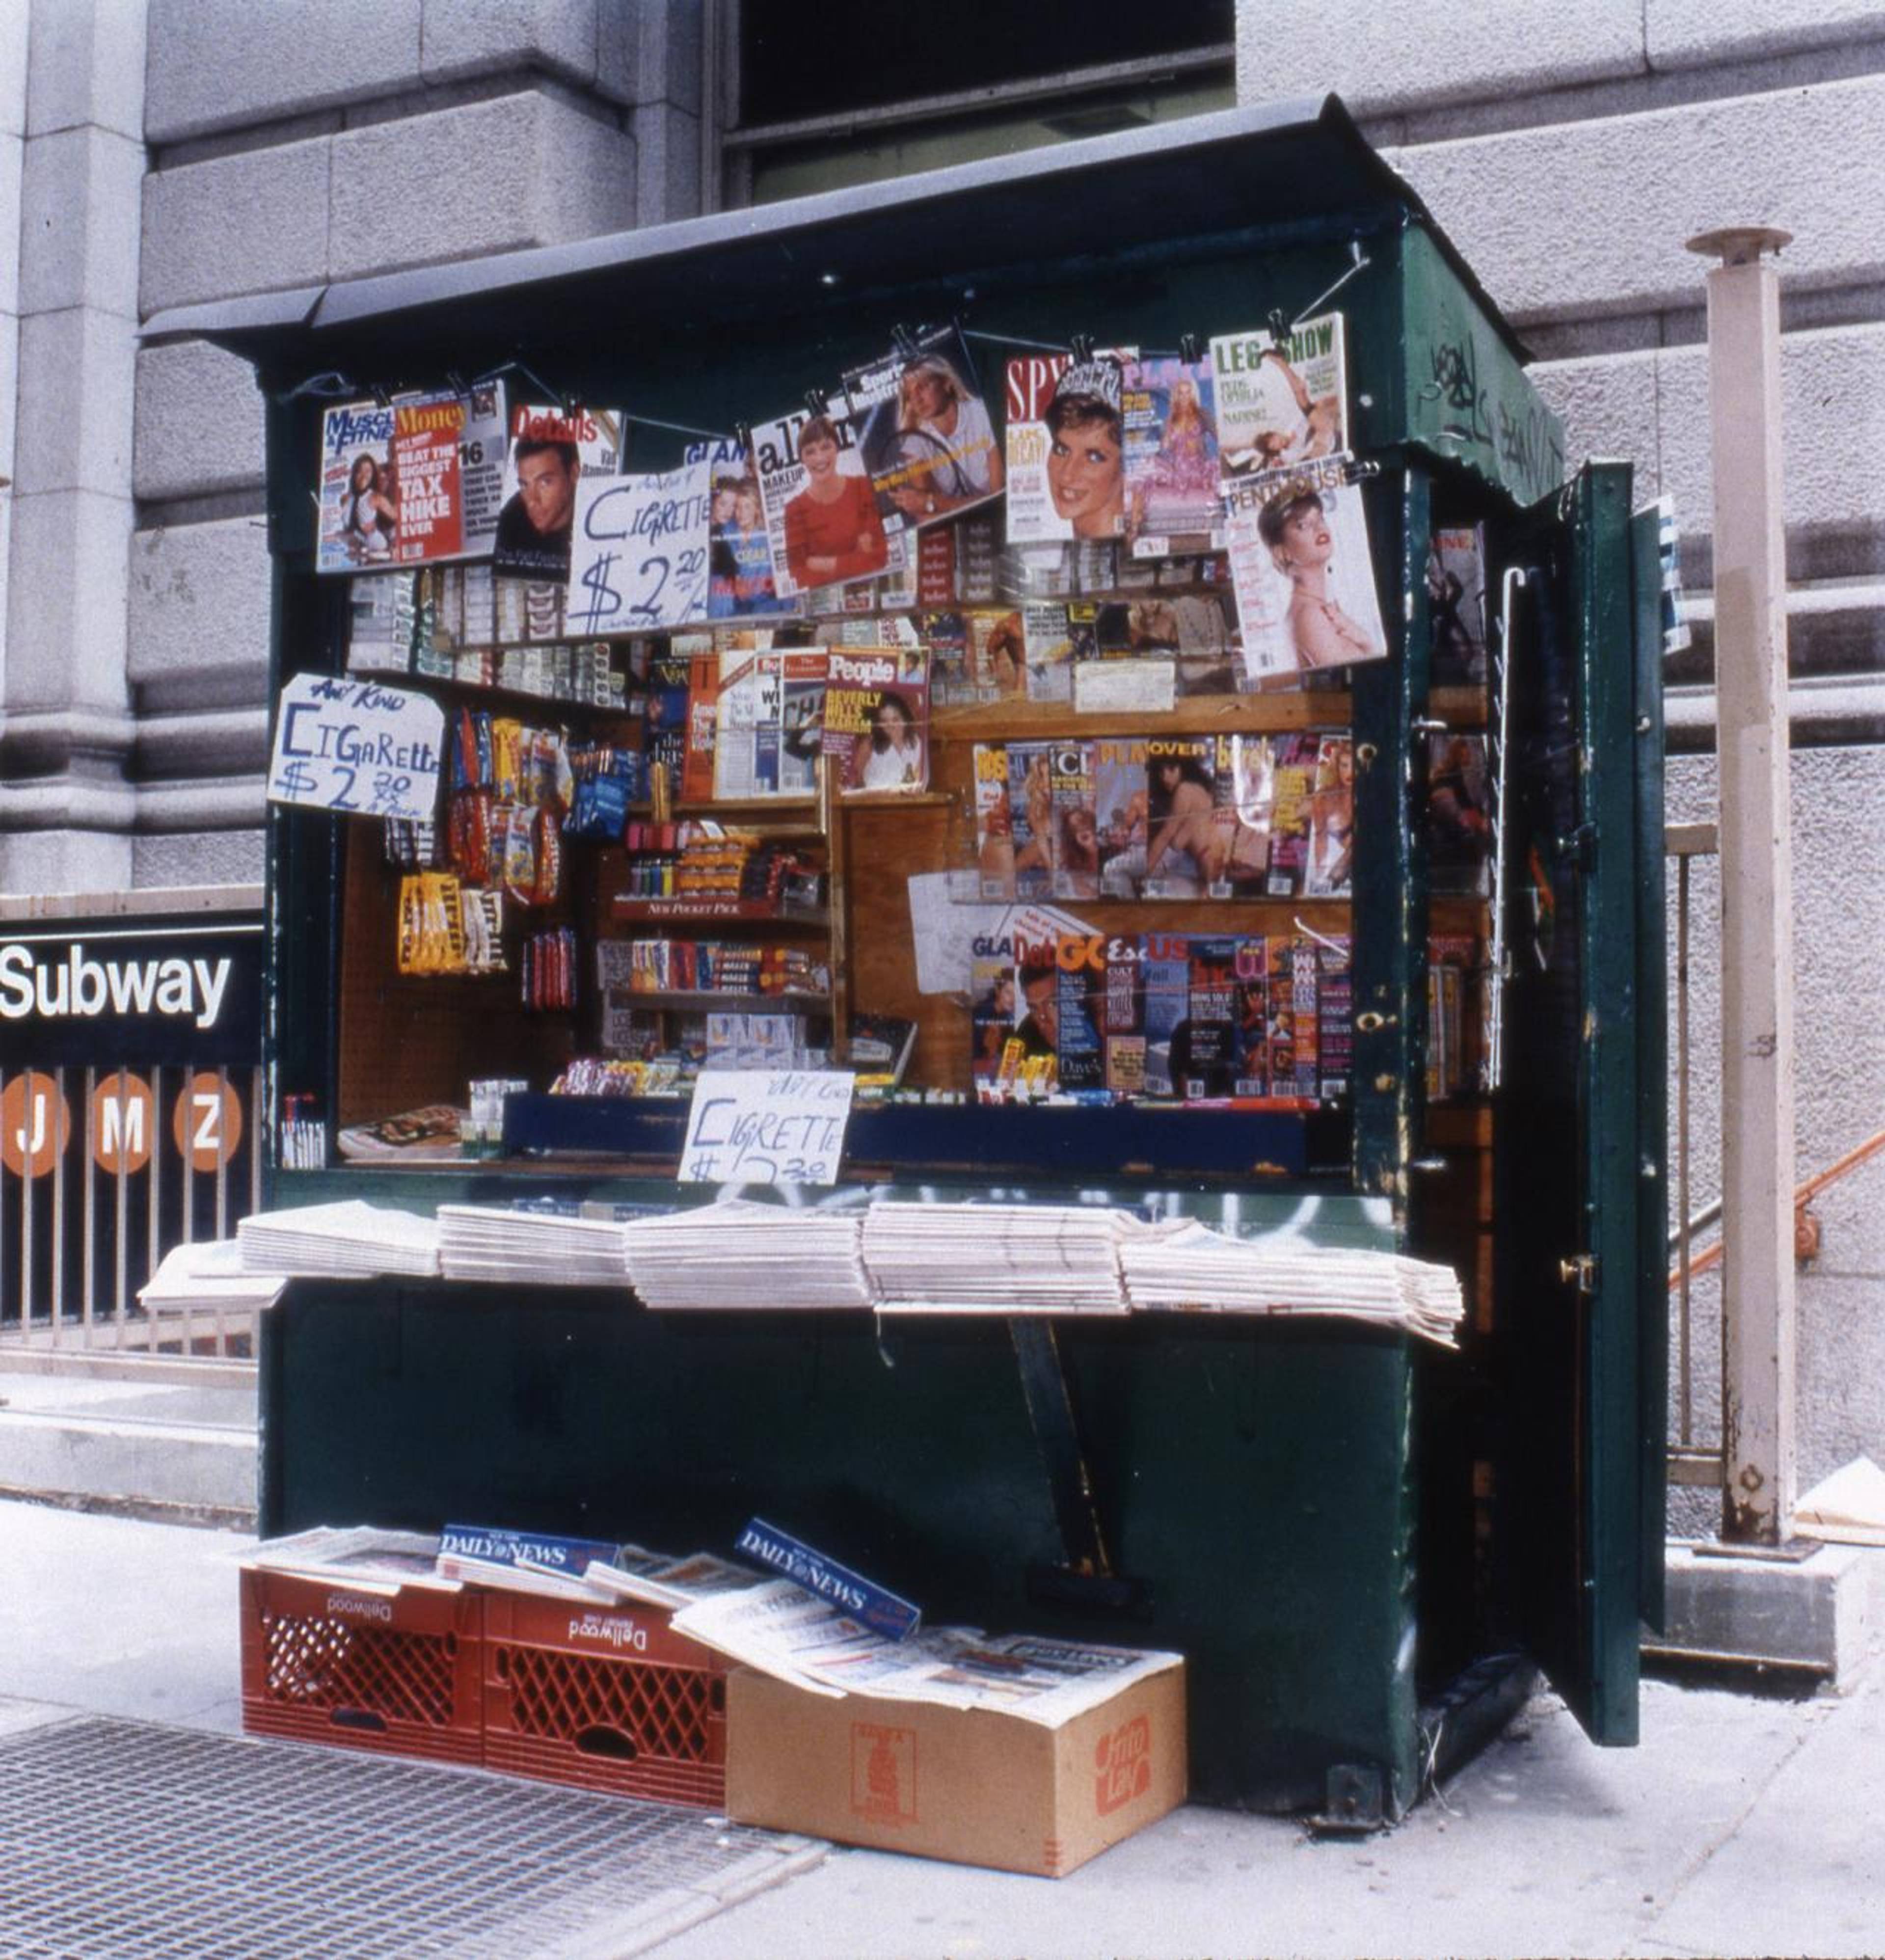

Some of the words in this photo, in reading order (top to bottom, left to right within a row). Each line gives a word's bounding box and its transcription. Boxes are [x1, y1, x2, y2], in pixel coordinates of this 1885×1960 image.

[1215, 339, 1262, 375] LEG
[1281, 320, 1333, 363] SHOW
[1006, 354, 1068, 423] SPY
[396, 405, 466, 436] Money
[512, 403, 598, 443] Details
[459, 441, 484, 466] 16
[400, 475, 443, 500] TAX
[400, 494, 451, 523] HIKE
[400, 520, 433, 538] EVER
[829, 654, 894, 687] People
[825, 704, 864, 720] HILLS
[826, 688, 882, 708] BEVERLY
[1149, 740, 1207, 756] OVER
[1147, 933, 1188, 962] US
[0, 944, 232, 1028] Subway
[16, 1094, 46, 1154] J
[102, 1096, 143, 1155] M
[192, 1094, 220, 1149] Z
[441, 1533, 496, 1557] DAILY
[506, 1543, 566, 1565] NEWS
[741, 1531, 794, 1572] DAILY
[809, 1566, 867, 1610] NEWS
[568, 1620, 647, 1651] Dellwood
